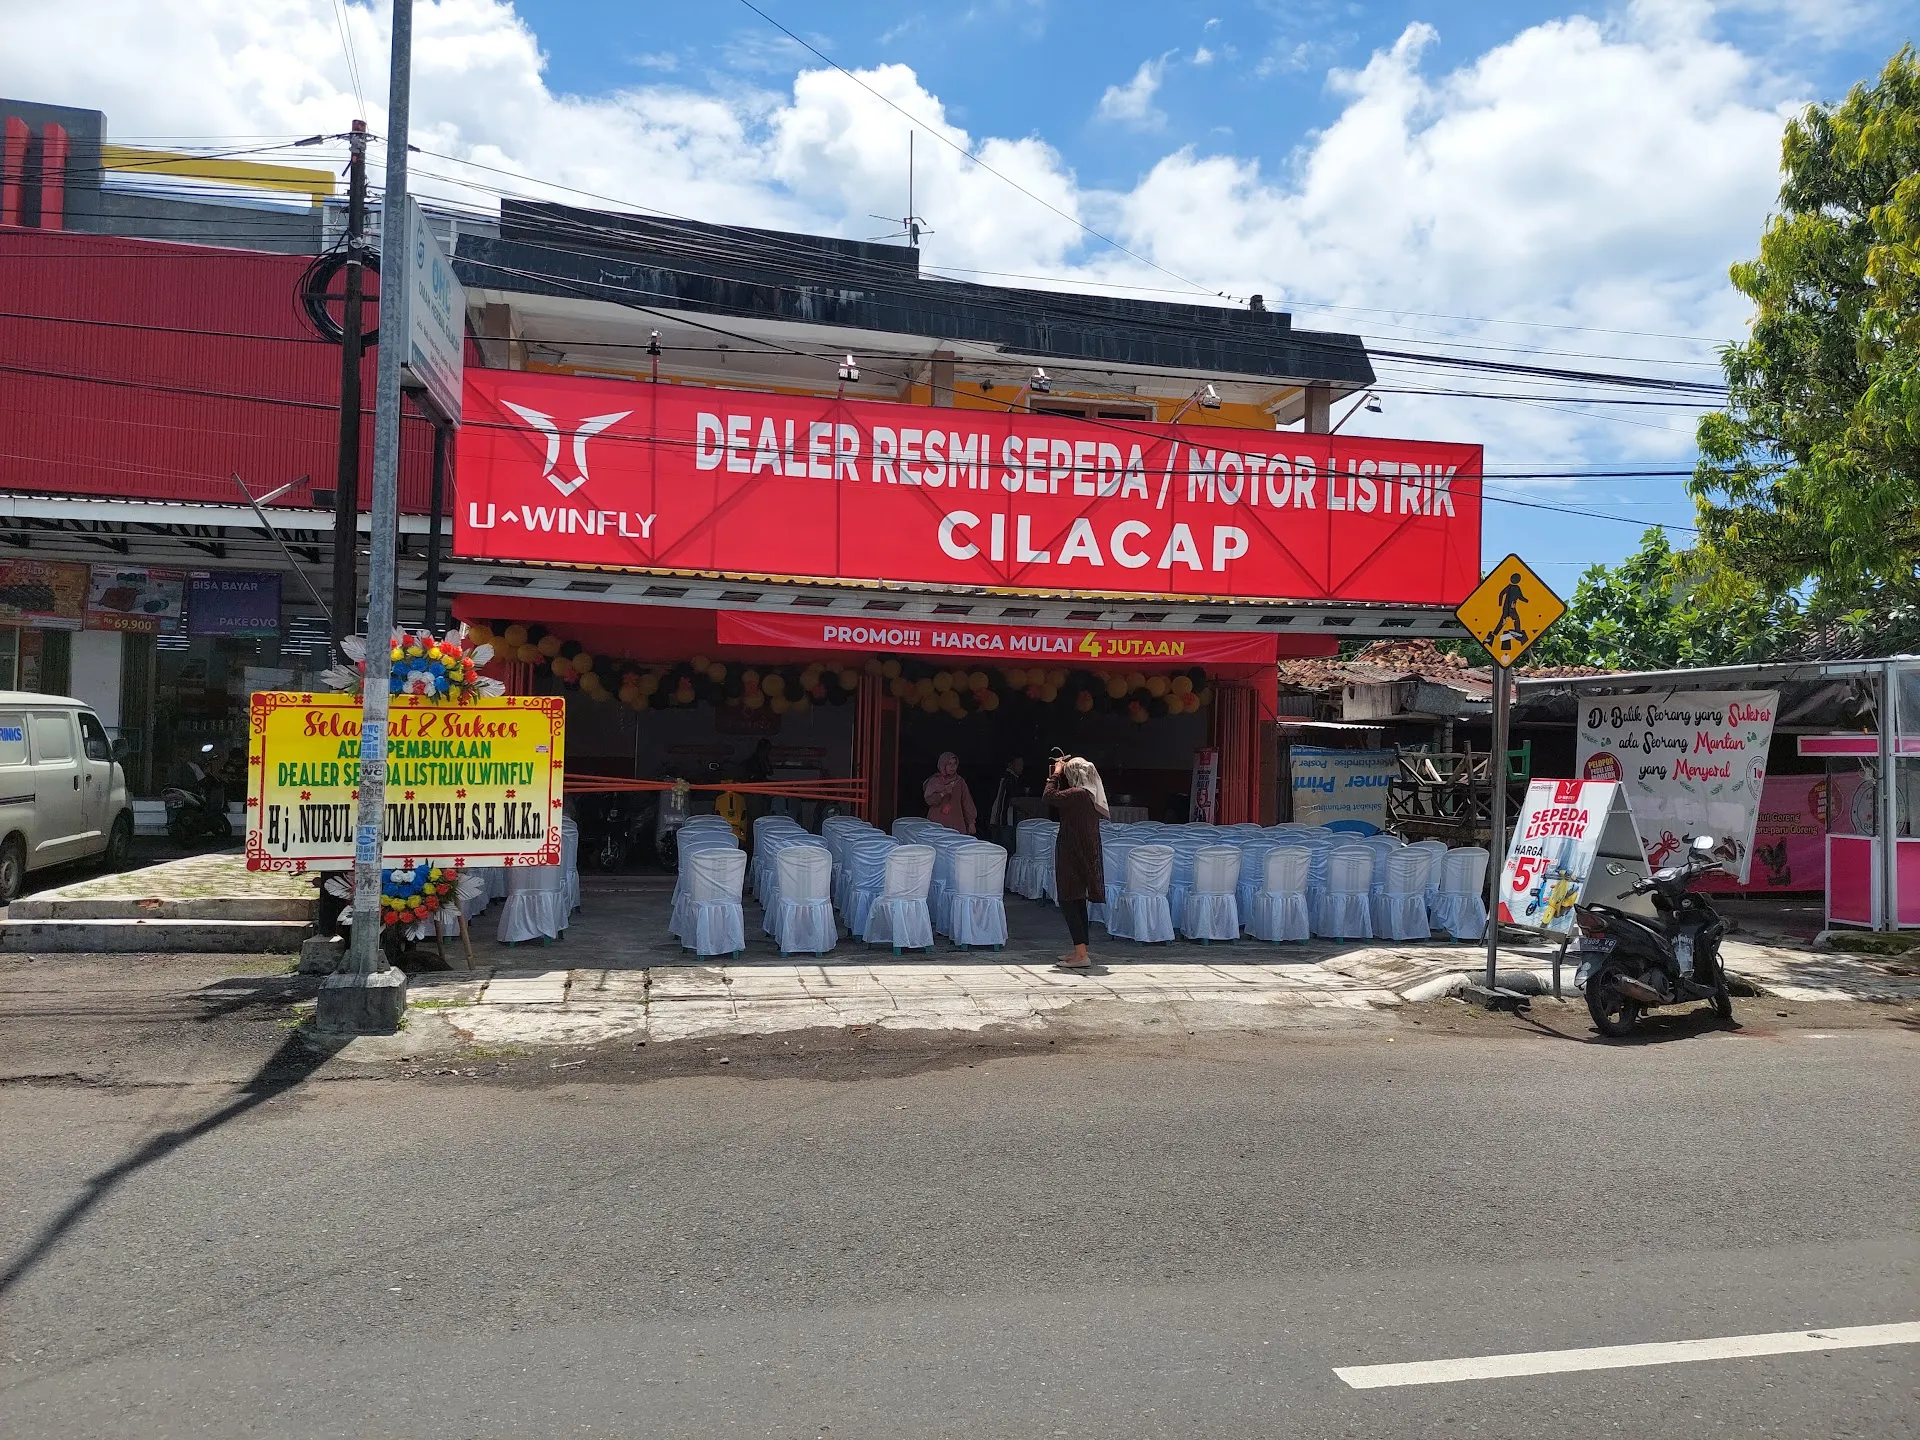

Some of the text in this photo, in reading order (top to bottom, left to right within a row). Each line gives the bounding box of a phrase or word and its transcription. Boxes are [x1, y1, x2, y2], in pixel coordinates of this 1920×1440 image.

[696, 412, 1457, 517] DEALER RESMI SEPEDA / MOTOR LISTRIK
[938, 510, 1249, 572] CILACAP
[193, 581, 258, 591] BISA BAYAR
[114, 619, 152, 630] 69.900
[220, 617, 278, 628] PAKE OVO
[823, 625, 1185, 658] PROMO!!! HARGA MULAI 4 JUTAAN
[303, 710, 521, 738] Selaat & Sukses
[1588, 707, 1608, 729] Di
[1611, 705, 1643, 729] Balik
[1645, 704, 1692, 728] Seorang
[1694, 708, 1723, 727] yang
[386, 740, 491, 759] PEMBUKAAN
[1618, 731, 1745, 754] ada Seorang Mantan
[361, 769, 383, 777] WC
[1299, 760, 1327, 769] Poster
[1638, 763, 1667, 781] yang
[278, 762, 340, 787] DEALER
[404, 762, 464, 786] LISTRIK
[1293, 776, 1336, 793] Print
[299, 803, 354, 844] NURUL
[1531, 808, 1588, 824] SEPEDA
[1525, 822, 1585, 839] LISTRIK
[1755, 826, 1789, 836] aru-paru
[1514, 844, 1543, 857] HARGA
